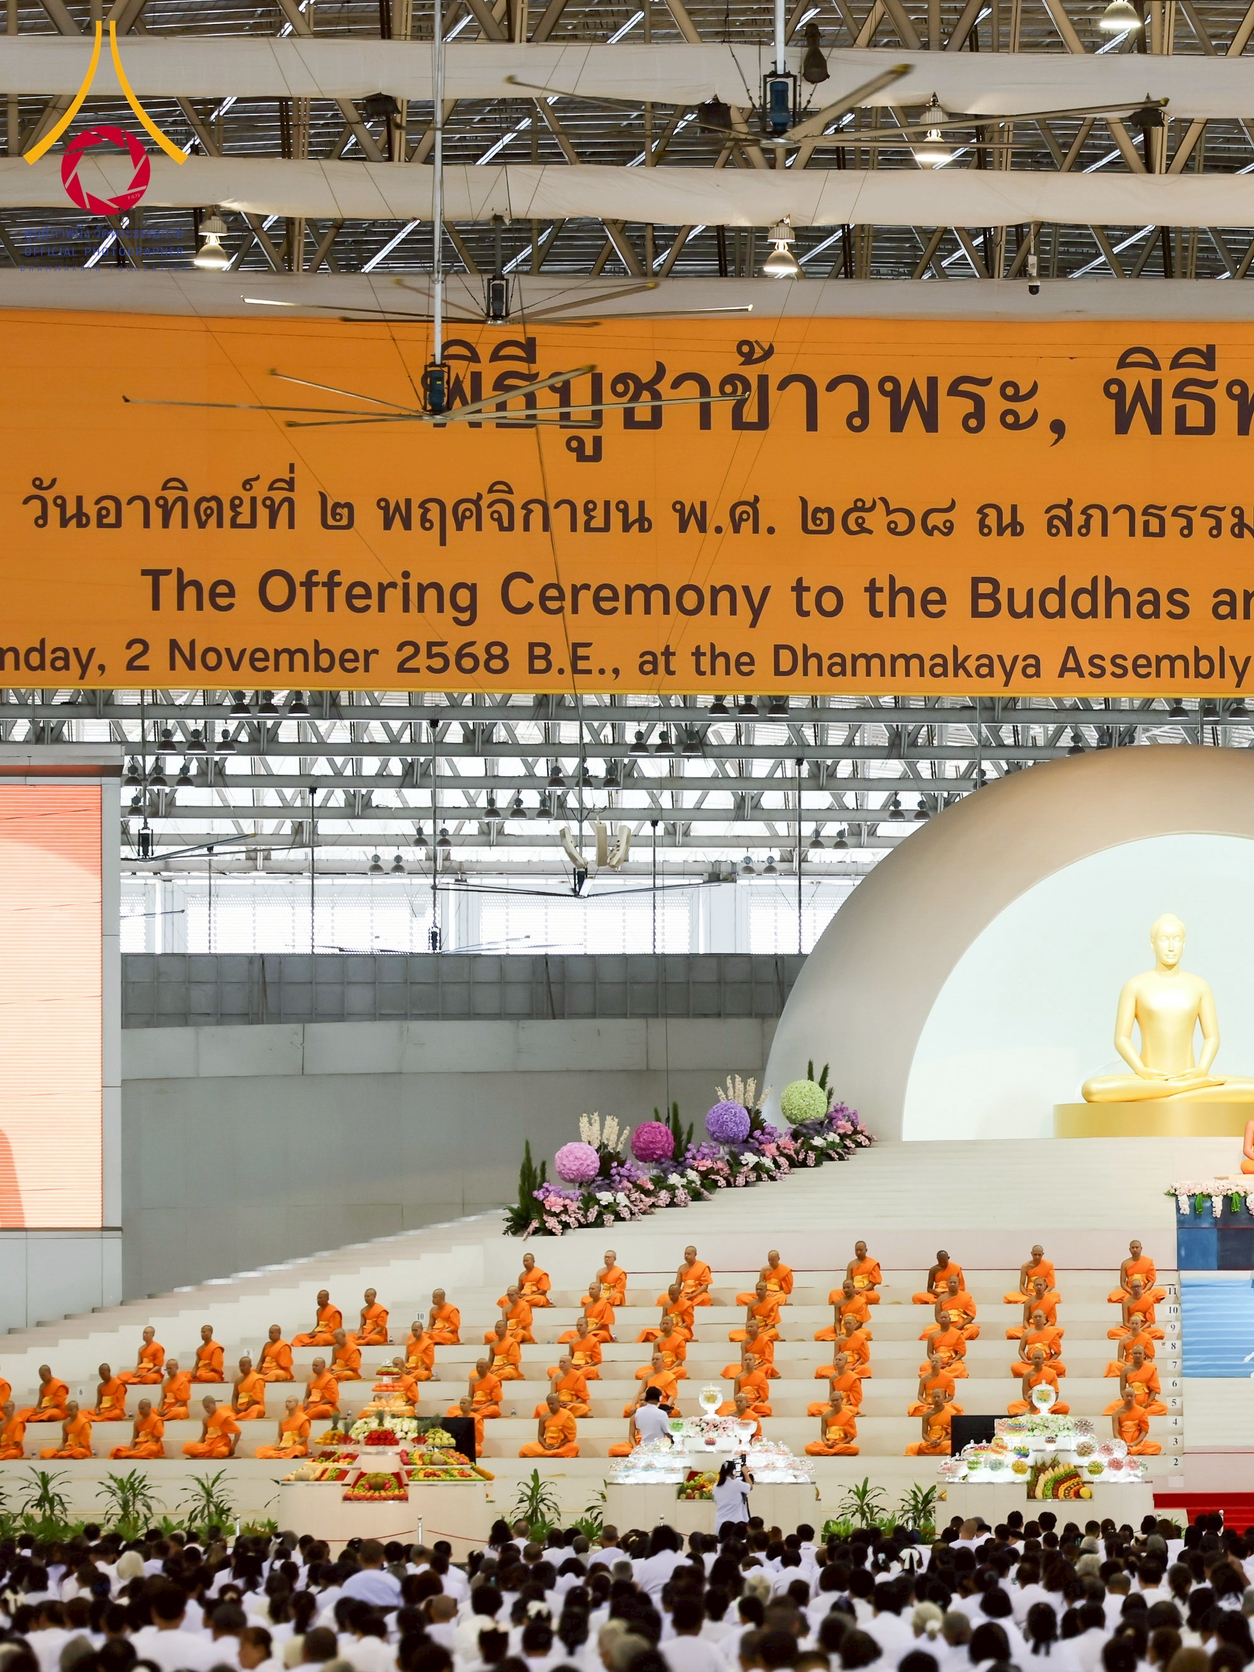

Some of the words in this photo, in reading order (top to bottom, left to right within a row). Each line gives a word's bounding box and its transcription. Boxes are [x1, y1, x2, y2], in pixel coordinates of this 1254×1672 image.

[22, 463, 296, 530] วันอาทิตย์ที่
[319, 491, 355, 531] ๒
[377, 480, 652, 546] พฤศจิกายน
[672, 495, 776, 535] พ.ศ.
[799, 495, 957, 537] ๒๕๖๘
[976, 503, 1025, 537] ณ
[141, 568, 236, 613] The
[258, 569, 478, 627] Offering
[500, 572, 771, 628] Ceremony
[791, 577, 844, 618] to
[864, 574, 947, 619] the
[971, 575, 1190, 620] Buddhas
[125, 638, 150, 672] 2
[169, 638, 380, 674] November
[396, 640, 510, 675] 2568
[529, 642, 620, 680] B.E.,
[638, 644, 677, 676] at
[691, 642, 756, 677] the
[774, 643, 1041, 688] Dhammakaya
[1057, 645, 1252, 689] Assembly
[1168, 1287, 1177, 1295] 11
[1168, 1306, 1179, 1314] 10
[1170, 1342, 1177, 1350] 8
[1172, 1361, 1178, 1369] 7
[1171, 1379, 1178, 1388] 6
[1171, 1398, 1177, 1407] 5
[1172, 1418, 1178, 1426] 4
[1172, 1437, 1179, 1446] 3
[1173, 1457, 1179, 1466] 2
